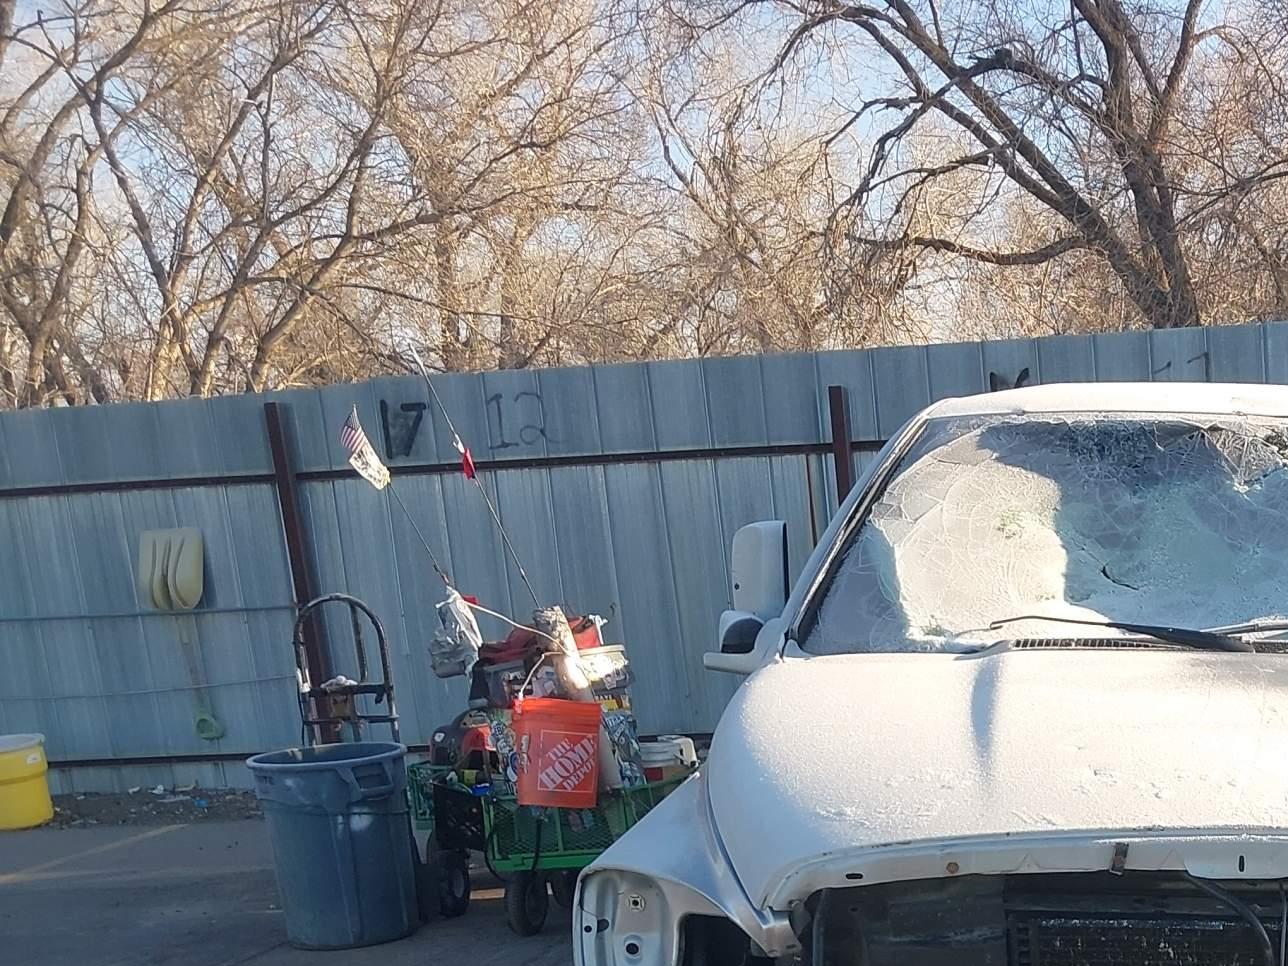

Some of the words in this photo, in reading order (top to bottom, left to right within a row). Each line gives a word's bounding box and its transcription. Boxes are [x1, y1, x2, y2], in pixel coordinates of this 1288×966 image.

[540, 735, 595, 790] HOME
[546, 739, 574, 761] THE
[562, 758, 595, 791] DEPOT
